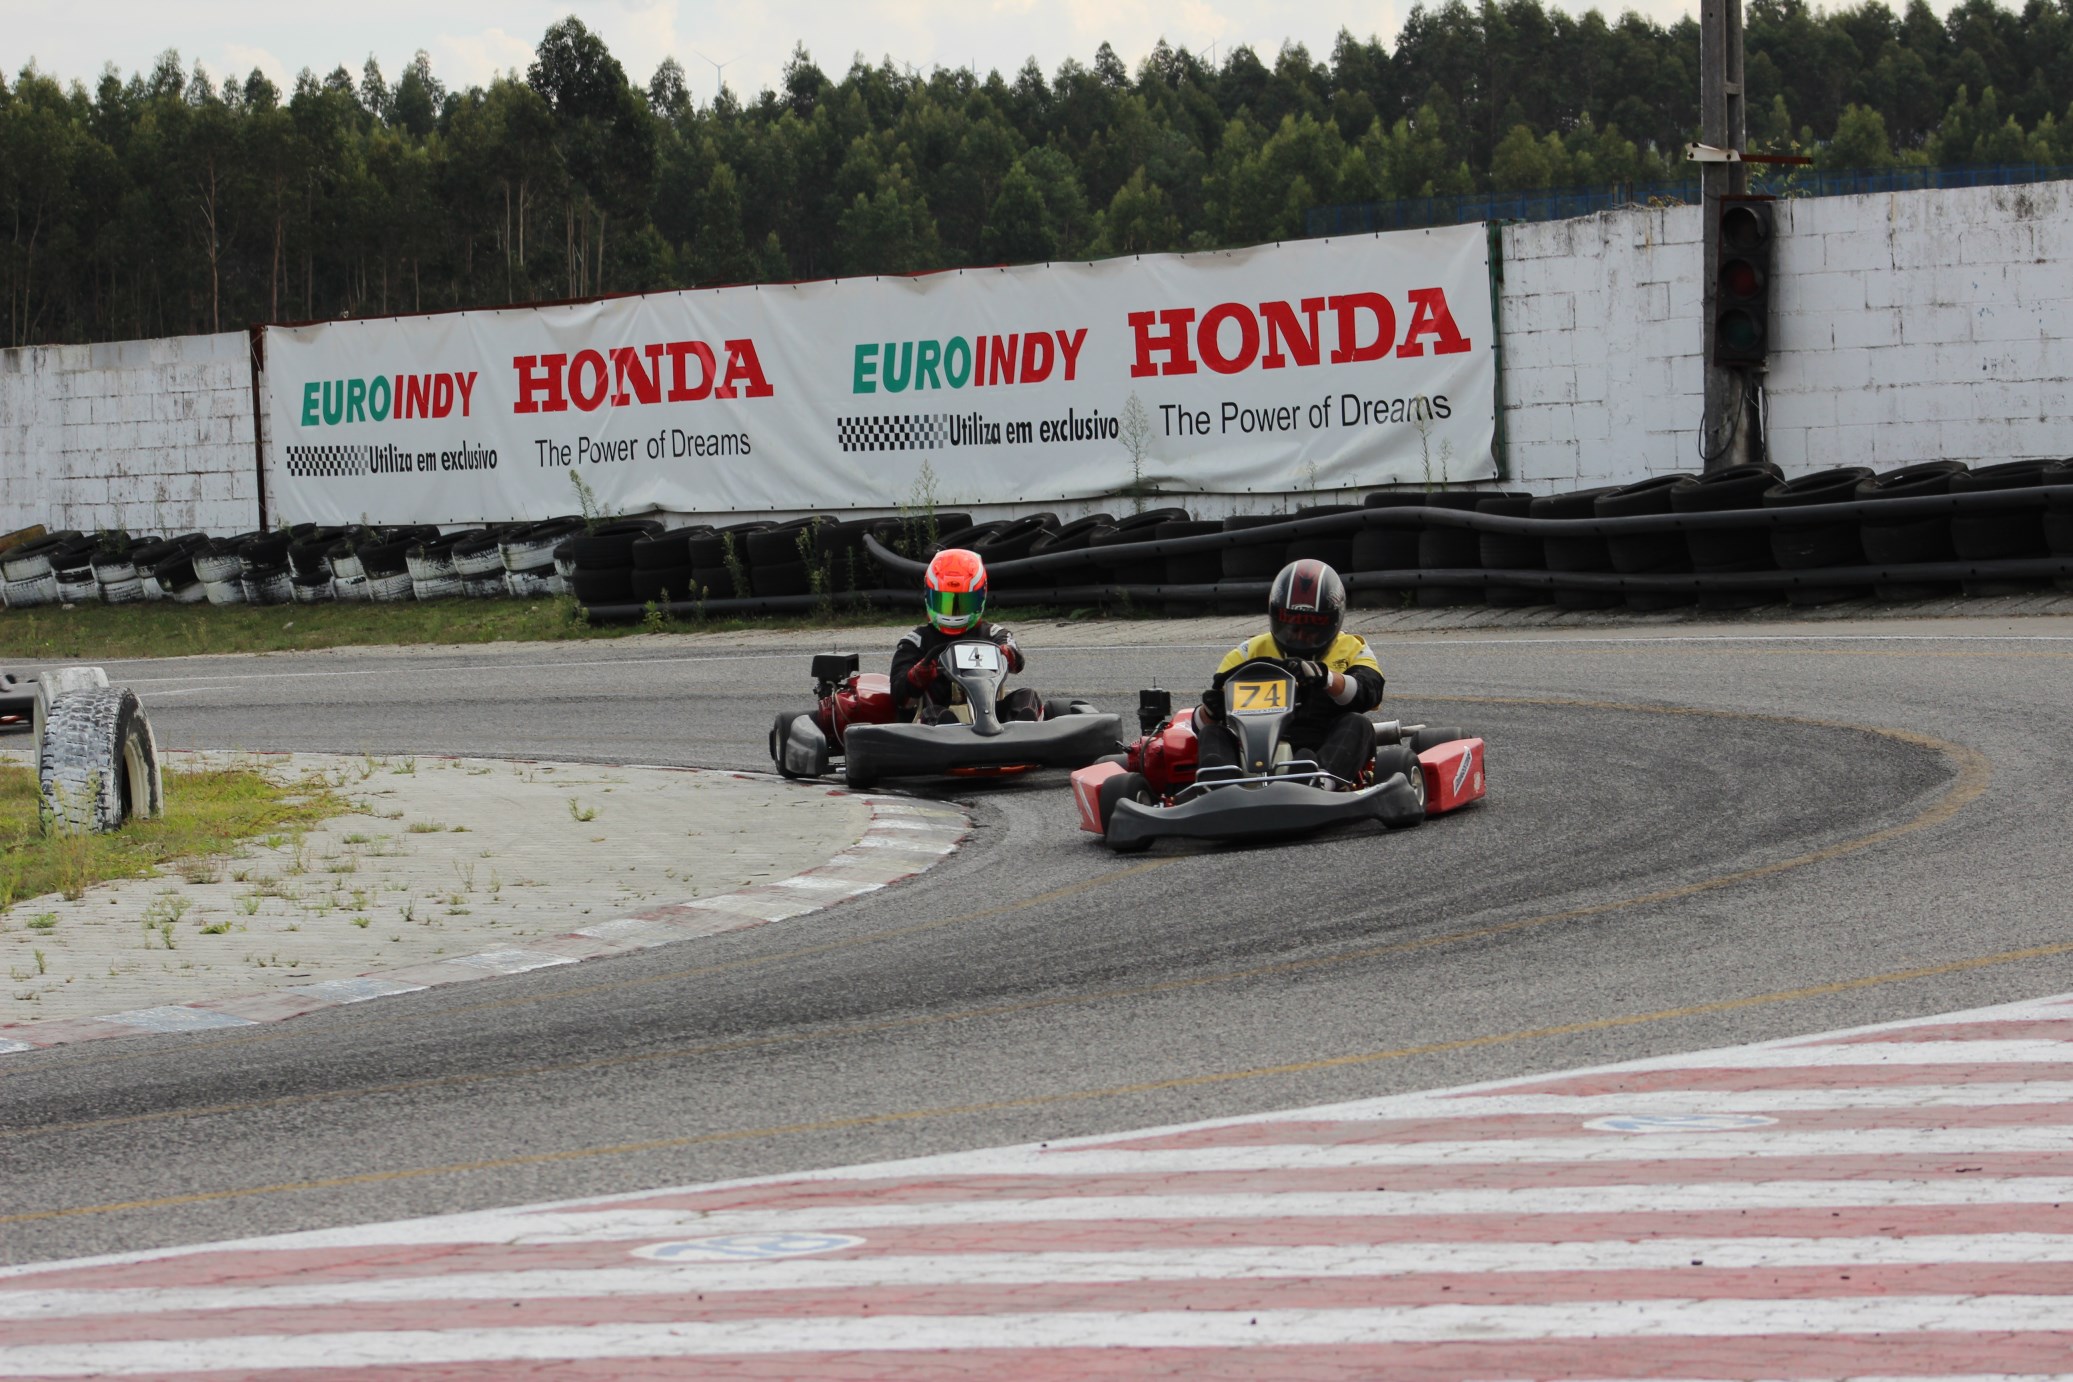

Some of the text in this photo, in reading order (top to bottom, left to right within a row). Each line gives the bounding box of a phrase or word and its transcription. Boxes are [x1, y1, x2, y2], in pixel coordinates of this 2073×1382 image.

[1127, 287, 1472, 378] HONDA
[513, 338, 775, 414] HONDA
[853, 327, 1088, 395] EUROINDY
[301, 371, 478, 427] EUROINDY
[1158, 392, 1452, 437] The Power of Dreams
[534, 428, 752, 468] The Power of Dreams
[950, 408, 1120, 447] Utiliza em exclusivo
[369, 440, 498, 474] Utiliza em exclusivo
[968, 647, 984, 667] 4
[1239, 683, 1281, 707] 74
